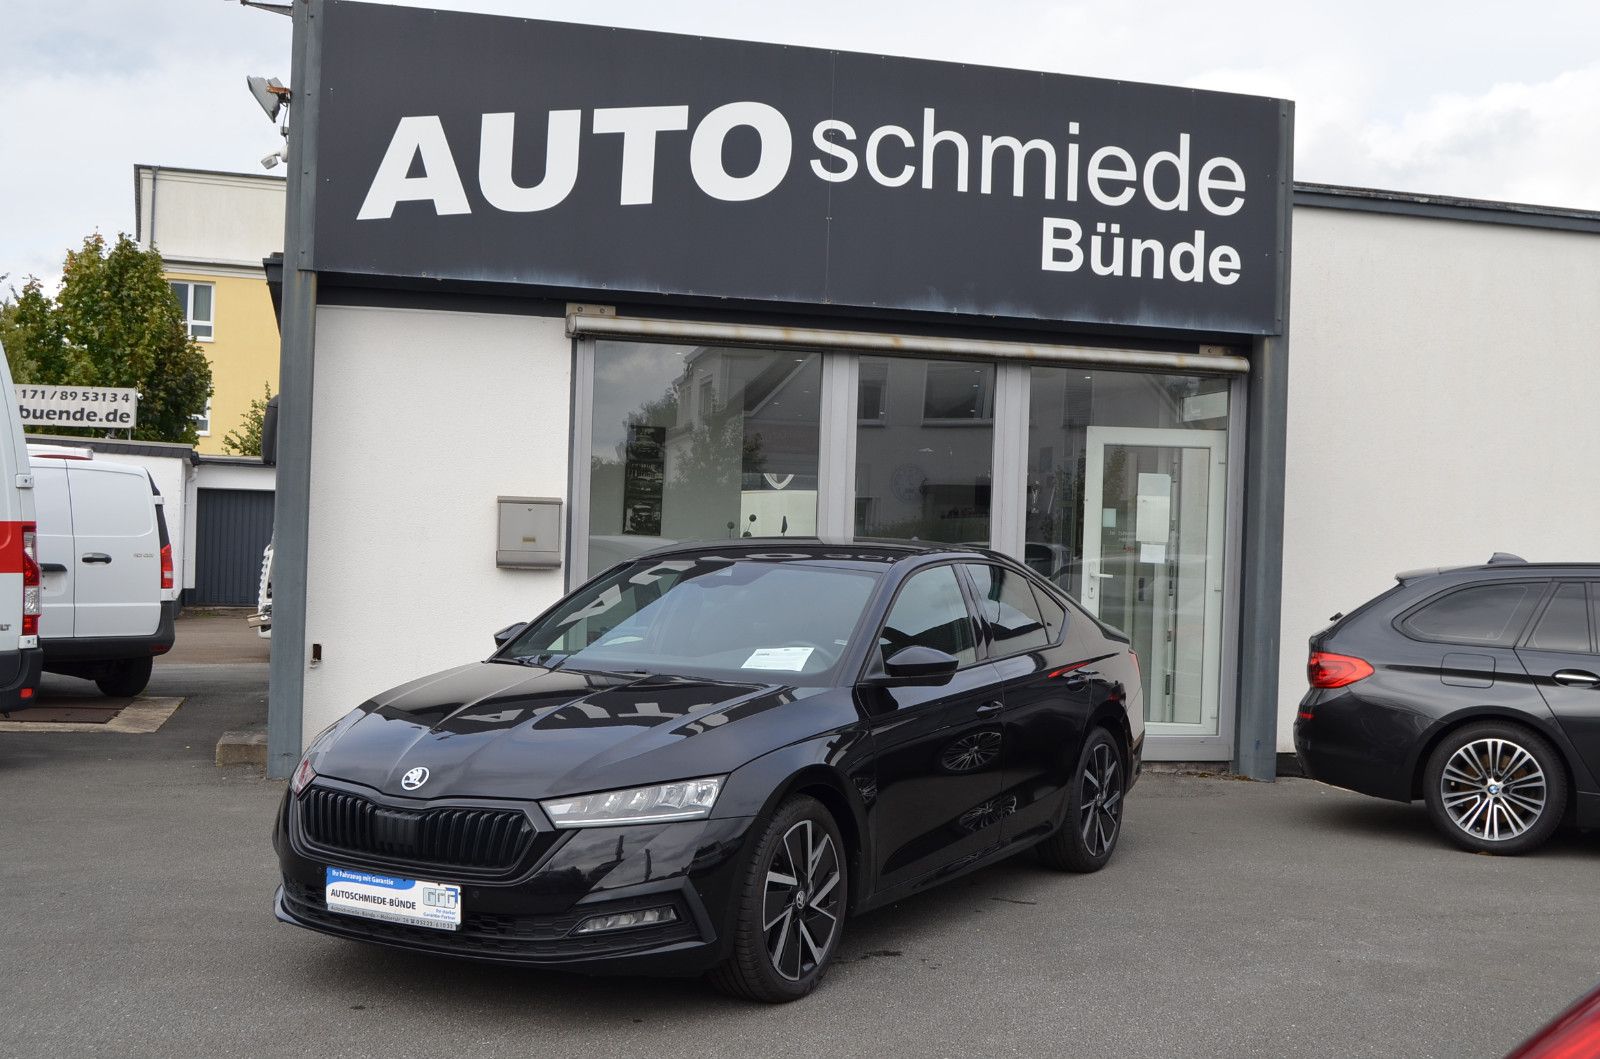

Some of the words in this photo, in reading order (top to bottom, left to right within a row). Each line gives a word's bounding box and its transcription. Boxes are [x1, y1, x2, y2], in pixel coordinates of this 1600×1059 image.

[1041, 217, 1241, 285] Bünde
[339, 871, 361, 881] Fahrzeug
[372, 877, 393, 885] Garantie
[331, 889, 416, 909] AUTOSCHMIEDE-BÜNDE
